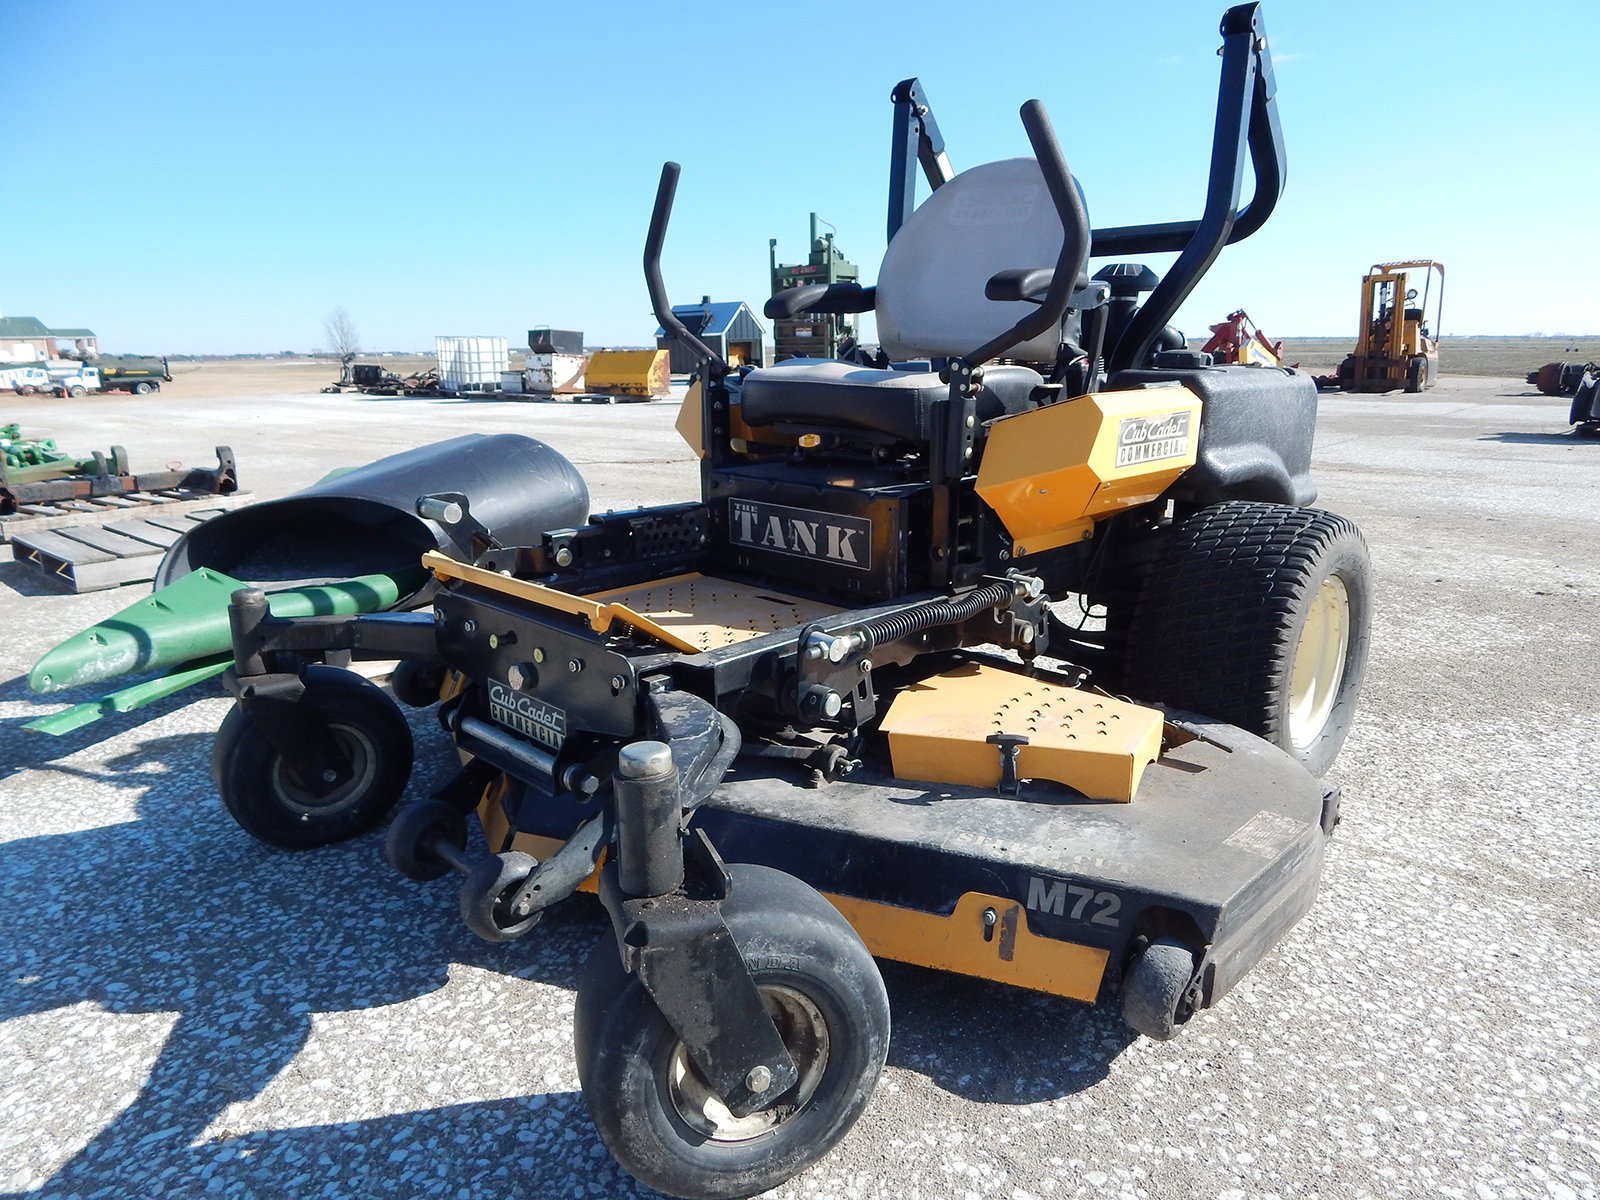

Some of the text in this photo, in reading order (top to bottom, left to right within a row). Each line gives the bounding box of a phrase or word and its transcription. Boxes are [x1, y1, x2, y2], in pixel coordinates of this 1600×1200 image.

[1121, 417, 1188, 444] Cub Cadet
[1120, 439, 1184, 463] COMMERCIAL
[734, 502, 758, 513] THE
[734, 509, 858, 563] TANK
[490, 685, 564, 731] Cub Cadet
[1026, 876, 1122, 928] M72
[745, 955, 801, 972] NDA
